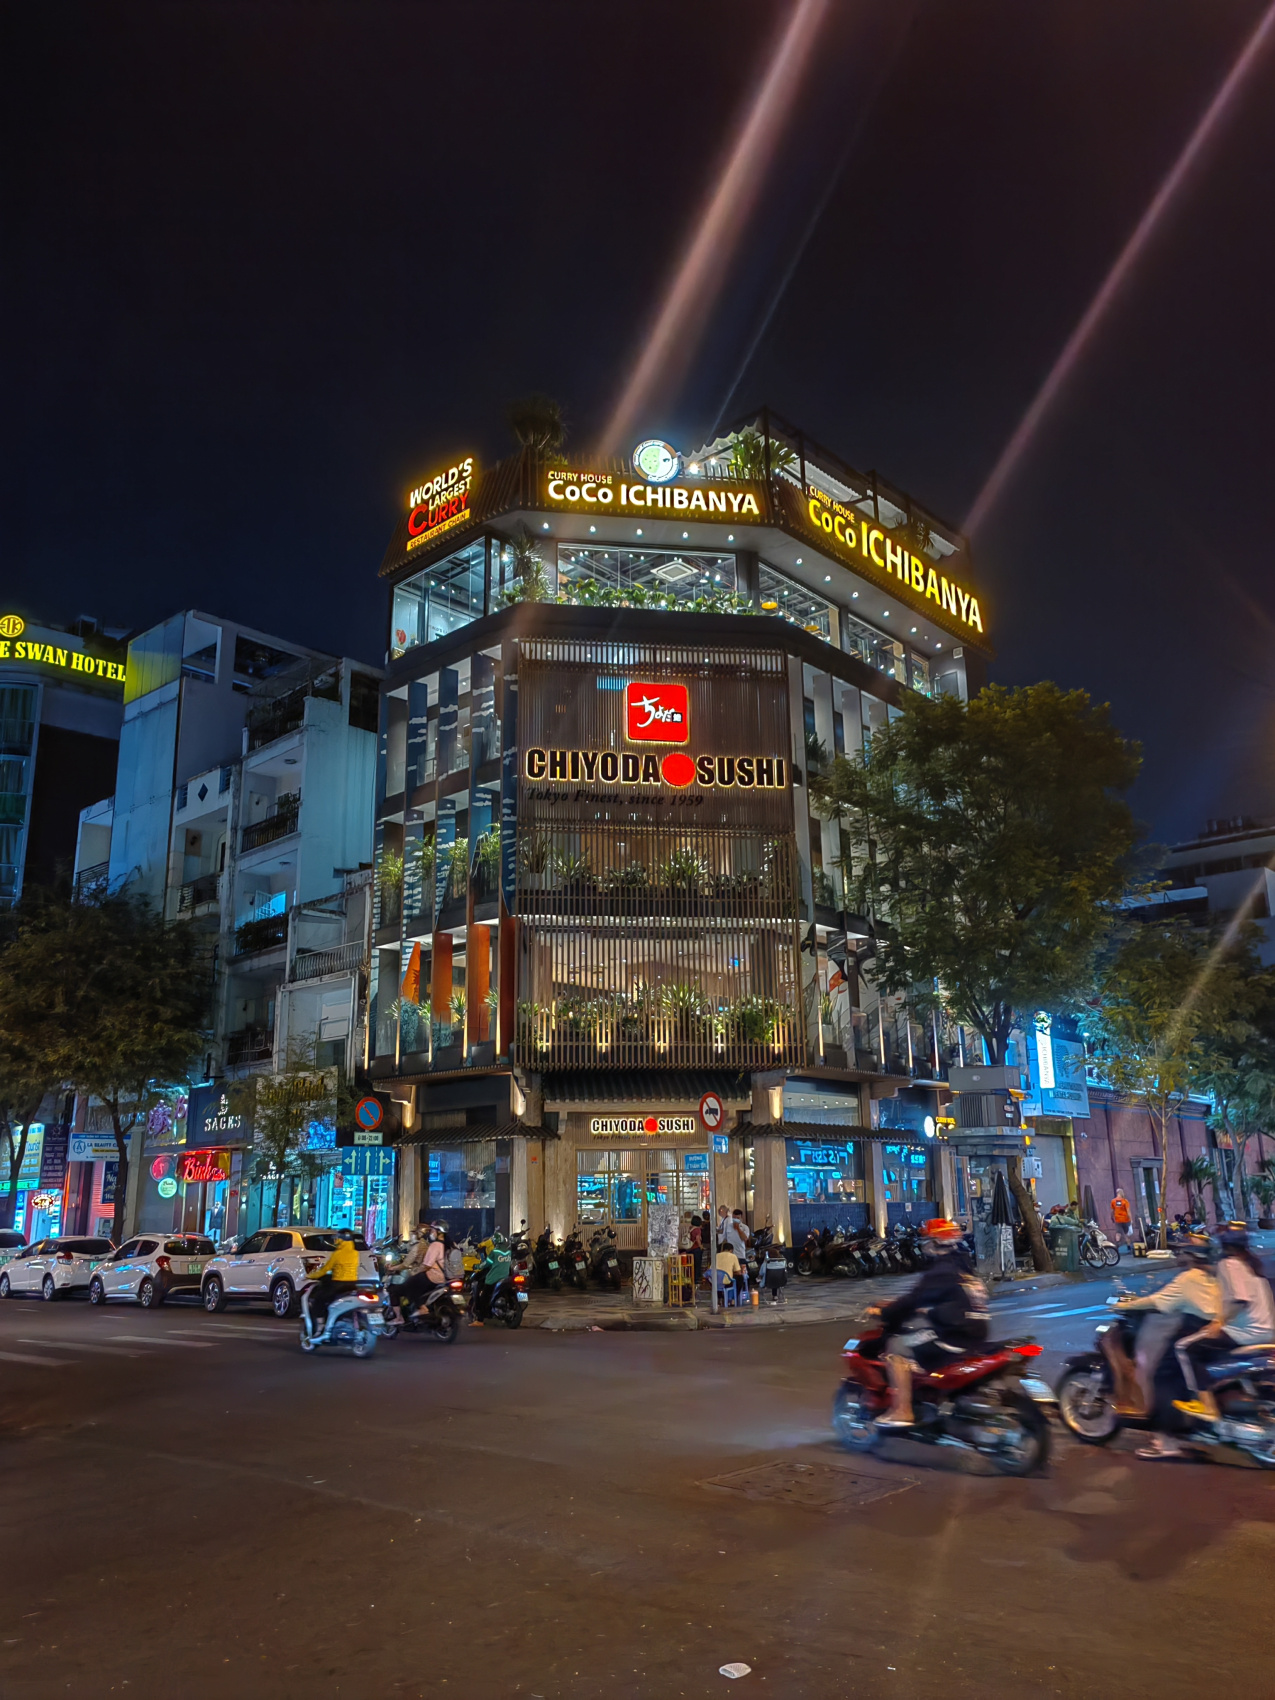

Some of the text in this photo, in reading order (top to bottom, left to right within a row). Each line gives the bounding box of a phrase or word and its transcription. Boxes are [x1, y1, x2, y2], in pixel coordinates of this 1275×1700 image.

[409, 457, 473, 509] WORLD'S
[429, 476, 472, 511] LARGEST
[547, 471, 613, 484] CURRY HOUSE
[408, 490, 470, 536] CURRY
[548, 481, 760, 515] CoCo ICHIBANYA
[809, 486, 856, 523] CURRY HOUSE
[410, 513, 466, 548] RESTAURANT CHAIN
[808, 499, 984, 634] CoCo ICHIBANYA
[14, 641, 69, 667] SWAN
[70, 651, 126, 682] HOTEL
[526, 748, 787, 788] CHIYODA SUSHI
[526, 788, 704, 807] Tokyo Finest, since 1959
[591, 1118, 695, 1133] CHIYODA SUSHI
